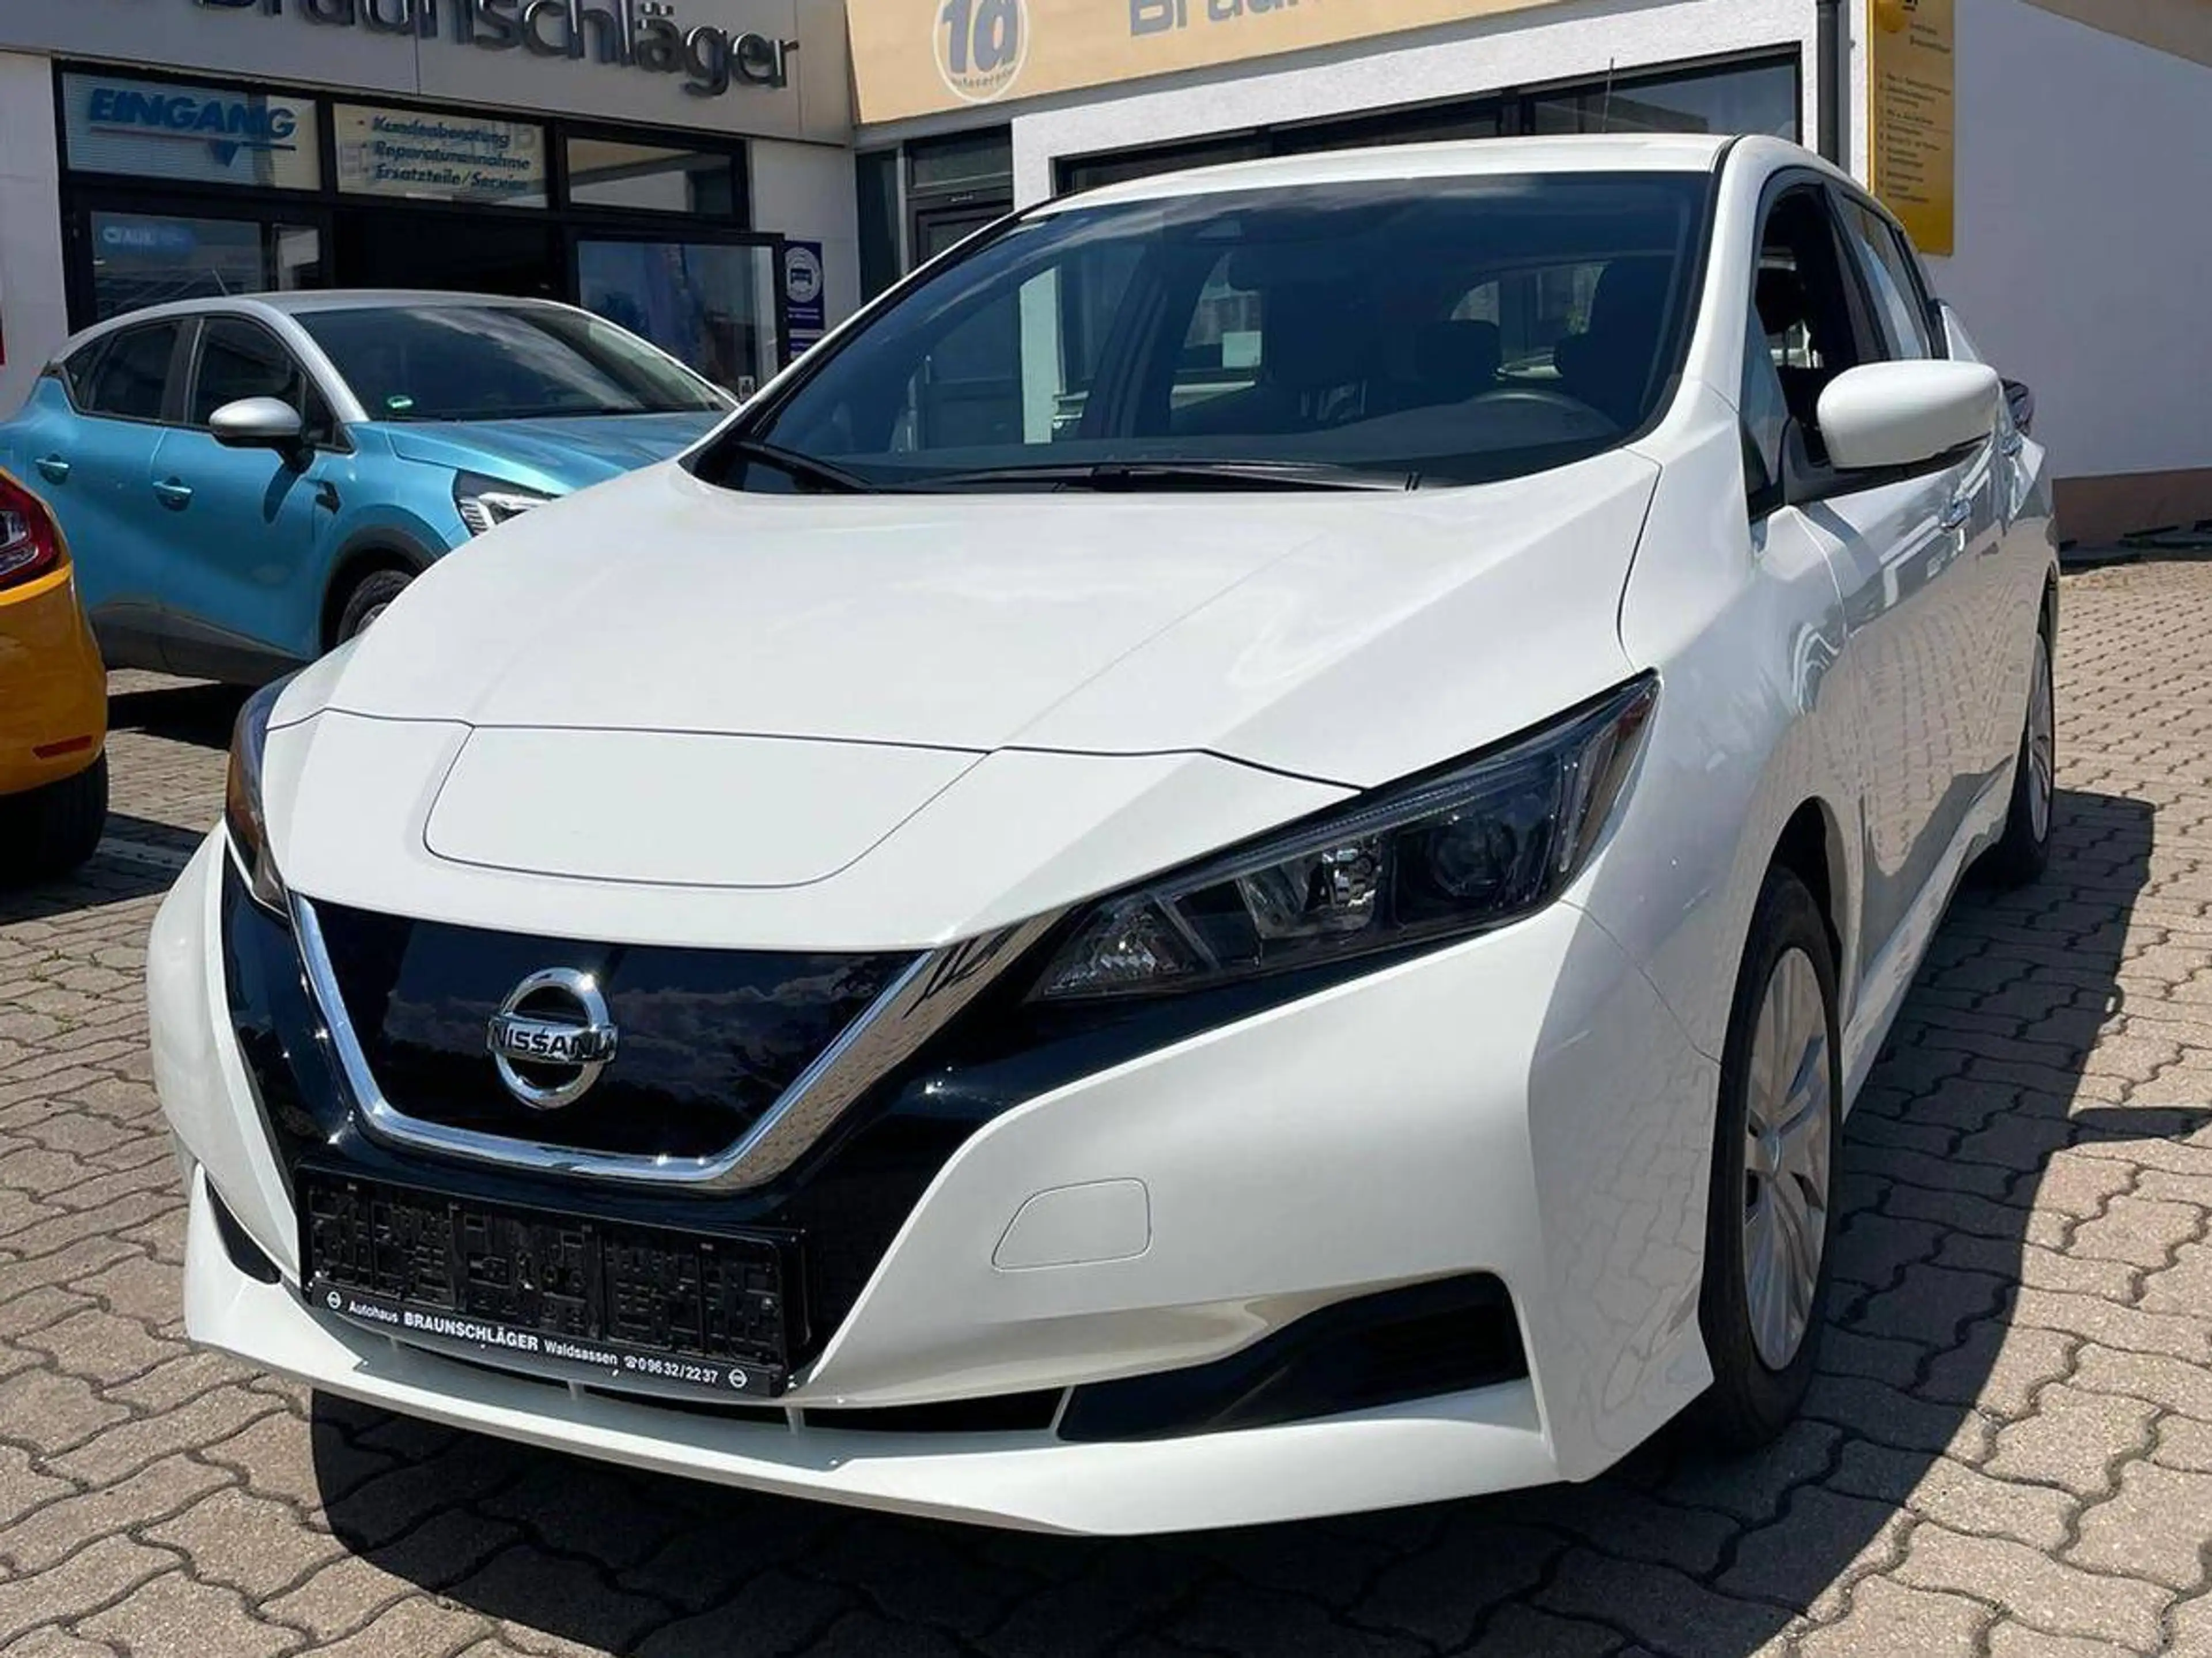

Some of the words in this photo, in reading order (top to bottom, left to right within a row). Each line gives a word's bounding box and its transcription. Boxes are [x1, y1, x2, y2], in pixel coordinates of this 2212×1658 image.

[191, 0, 800, 97] unschläger
[89, 88, 297, 139] EINGANG
[491, 1022, 594, 1059] NISSAN
[349, 1300, 399, 1323] Autohaus
[404, 1311, 539, 1351] BRAUNSCHLÄGER
[544, 1339, 619, 1365] Waldsassen
